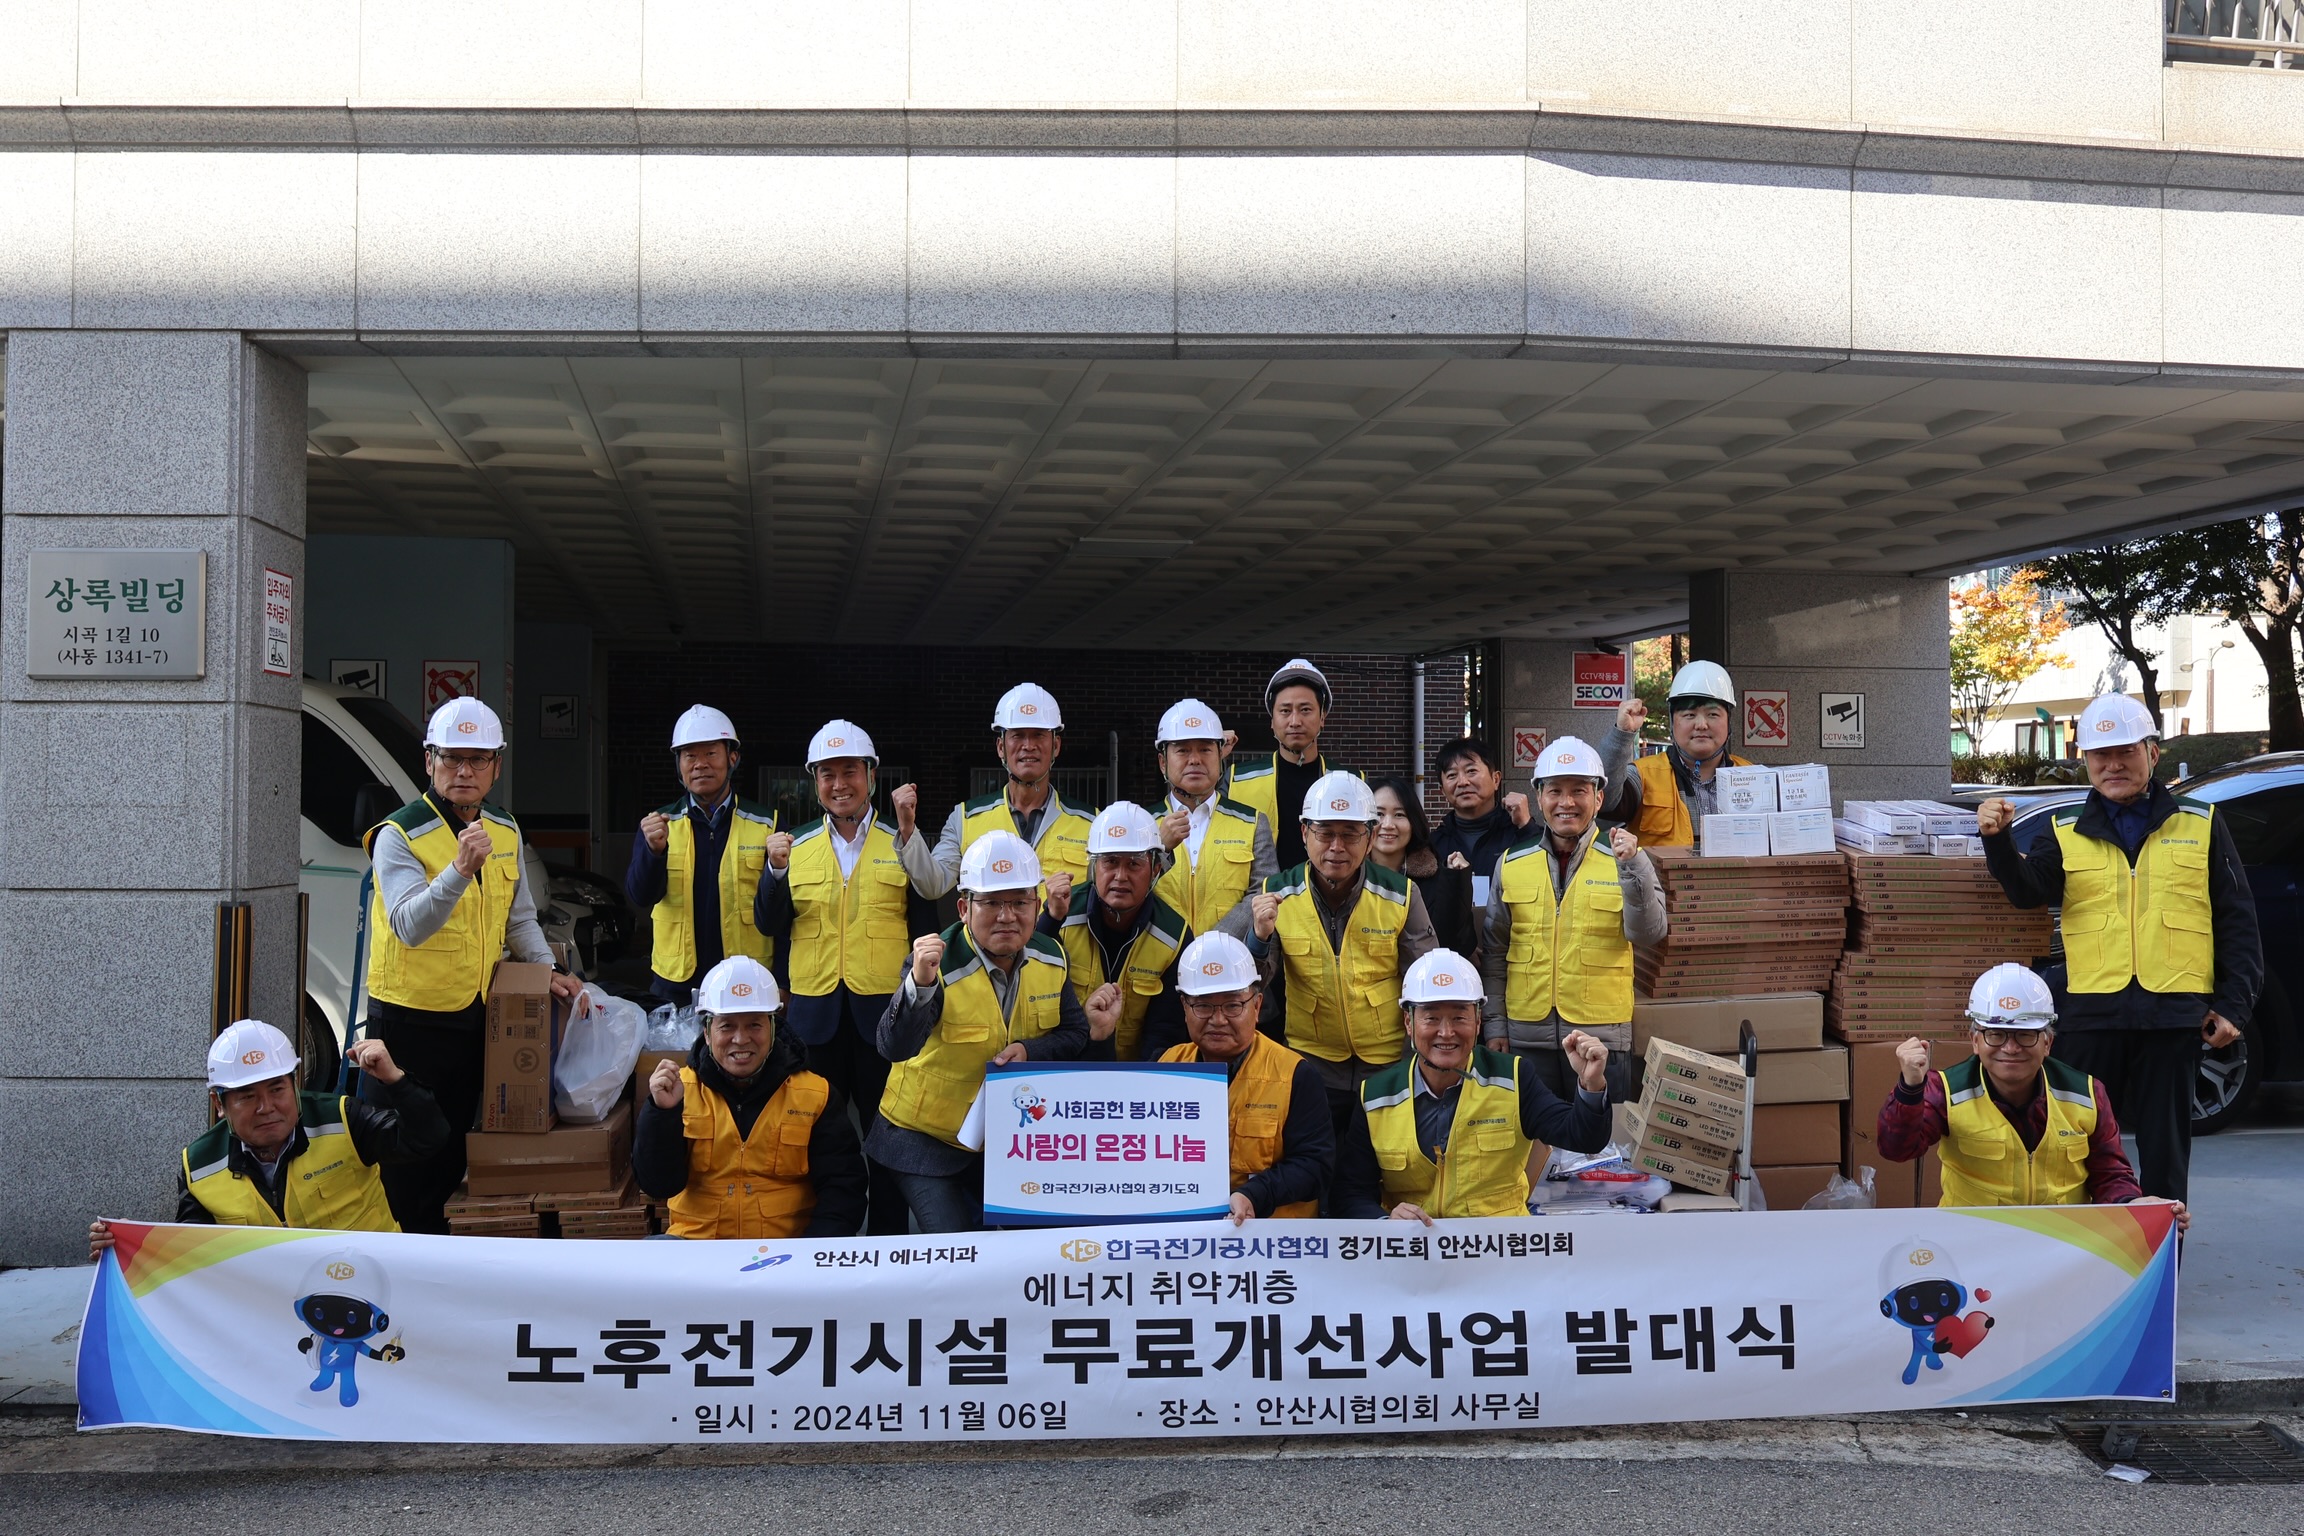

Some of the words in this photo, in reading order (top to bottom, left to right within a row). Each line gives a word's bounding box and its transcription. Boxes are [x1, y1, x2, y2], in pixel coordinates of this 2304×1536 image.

[45, 578, 183, 613] 상록빌딩
[266, 602, 291, 626] 주차금지
[64, 627, 97, 643] 시곡
[105, 626, 131, 643] 1길
[140, 627, 160, 643] 10
[56, 647, 98, 666] (사동
[105, 649, 169, 665] 1341-7)
[1580, 672, 1619, 682] CCTV작동중
[1576, 685, 1623, 699] SECOM
[1823, 733, 1863, 742] CCTV녹화중
[1052, 1101, 1123, 1119] 사회공헌
[1130, 1101, 1200, 1119] 봉사활동
[1007, 1134, 1086, 1161] 사랑의
[1096, 1134, 1146, 1161] 온정
[1155, 1135, 1205, 1162] 나눔
[1043, 1183, 1145, 1193] 한국전기공사협회
[1149, 1183, 1198, 1194] 경기도회
[814, 1250, 879, 1267] 안산시
[890, 1246, 978, 1265] 에너지과
[1107, 1236, 1328, 1260] 한국전기공사협회
[1339, 1236, 1428, 1260] 경기도회
[1438, 1233, 1572, 1259] 안산시협의회
[1024, 1273, 1132, 1307] 에너지
[1150, 1271, 1297, 1305] 취약계층
[508, 1318, 1008, 1389] 노후전기시설
[1044, 1305, 1528, 1384] 무료개선사업
[1566, 1305, 1794, 1374] 발대식
[695, 1405, 753, 1433] 일시
[794, 1403, 902, 1431] 2024년
[920, 1402, 984, 1431] 11월
[998, 1401, 1066, 1430] 06일
[1159, 1399, 1218, 1428] 장소
[1257, 1395, 1437, 1425] 안산시협의회
[1451, 1392, 1539, 1421] 사무실
